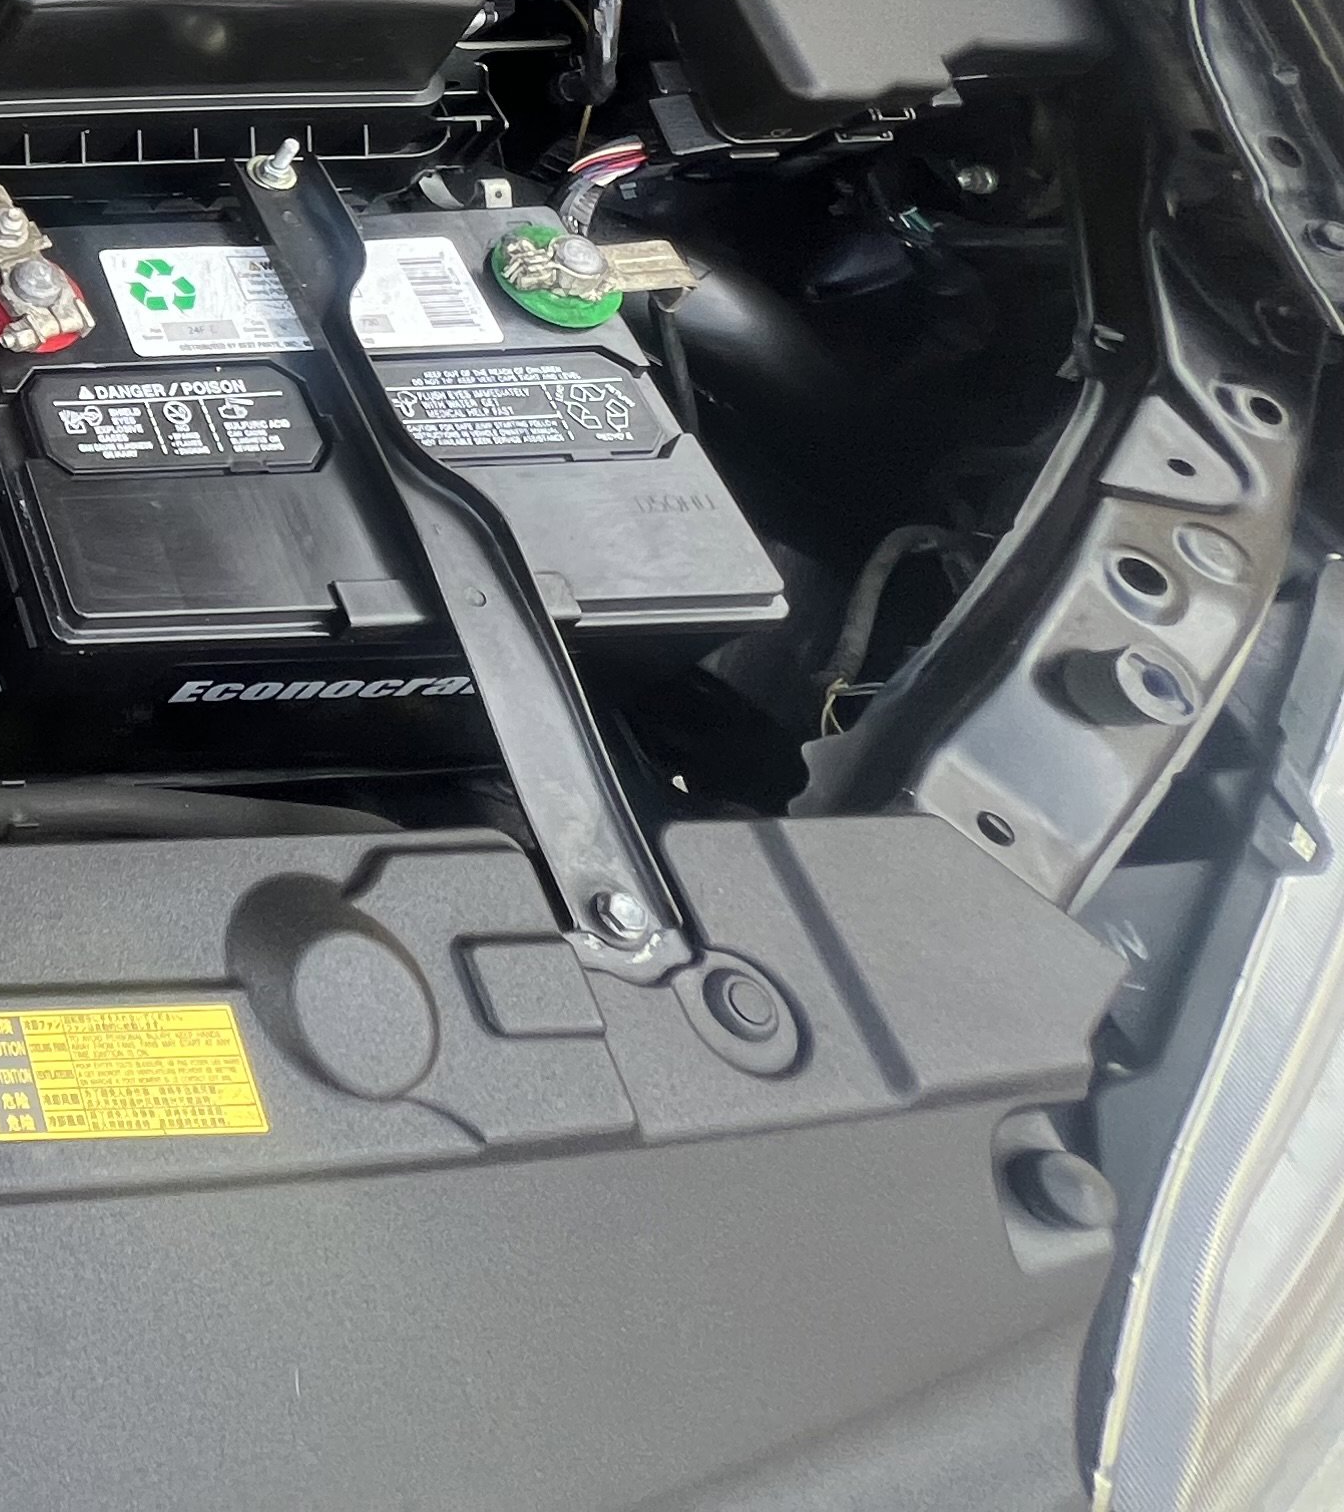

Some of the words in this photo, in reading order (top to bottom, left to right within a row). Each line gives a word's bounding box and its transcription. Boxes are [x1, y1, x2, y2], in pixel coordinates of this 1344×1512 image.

[94, 384, 166, 400] DANGER
[181, 379, 247, 396] POISON
[417, 390, 447, 401] FLUSH
[448, 389, 472, 399] EYES
[474, 387, 530, 399] IMMEDIATELY
[421, 400, 445, 410] WITH
[445, 398, 479, 409] WATER
[481, 397, 500, 407] GET
[425, 407, 466, 418] MEDICAL
[467, 406, 491, 416] HELP
[491, 405, 515, 416] FAST
[168, 676, 475, 703] Econocra
